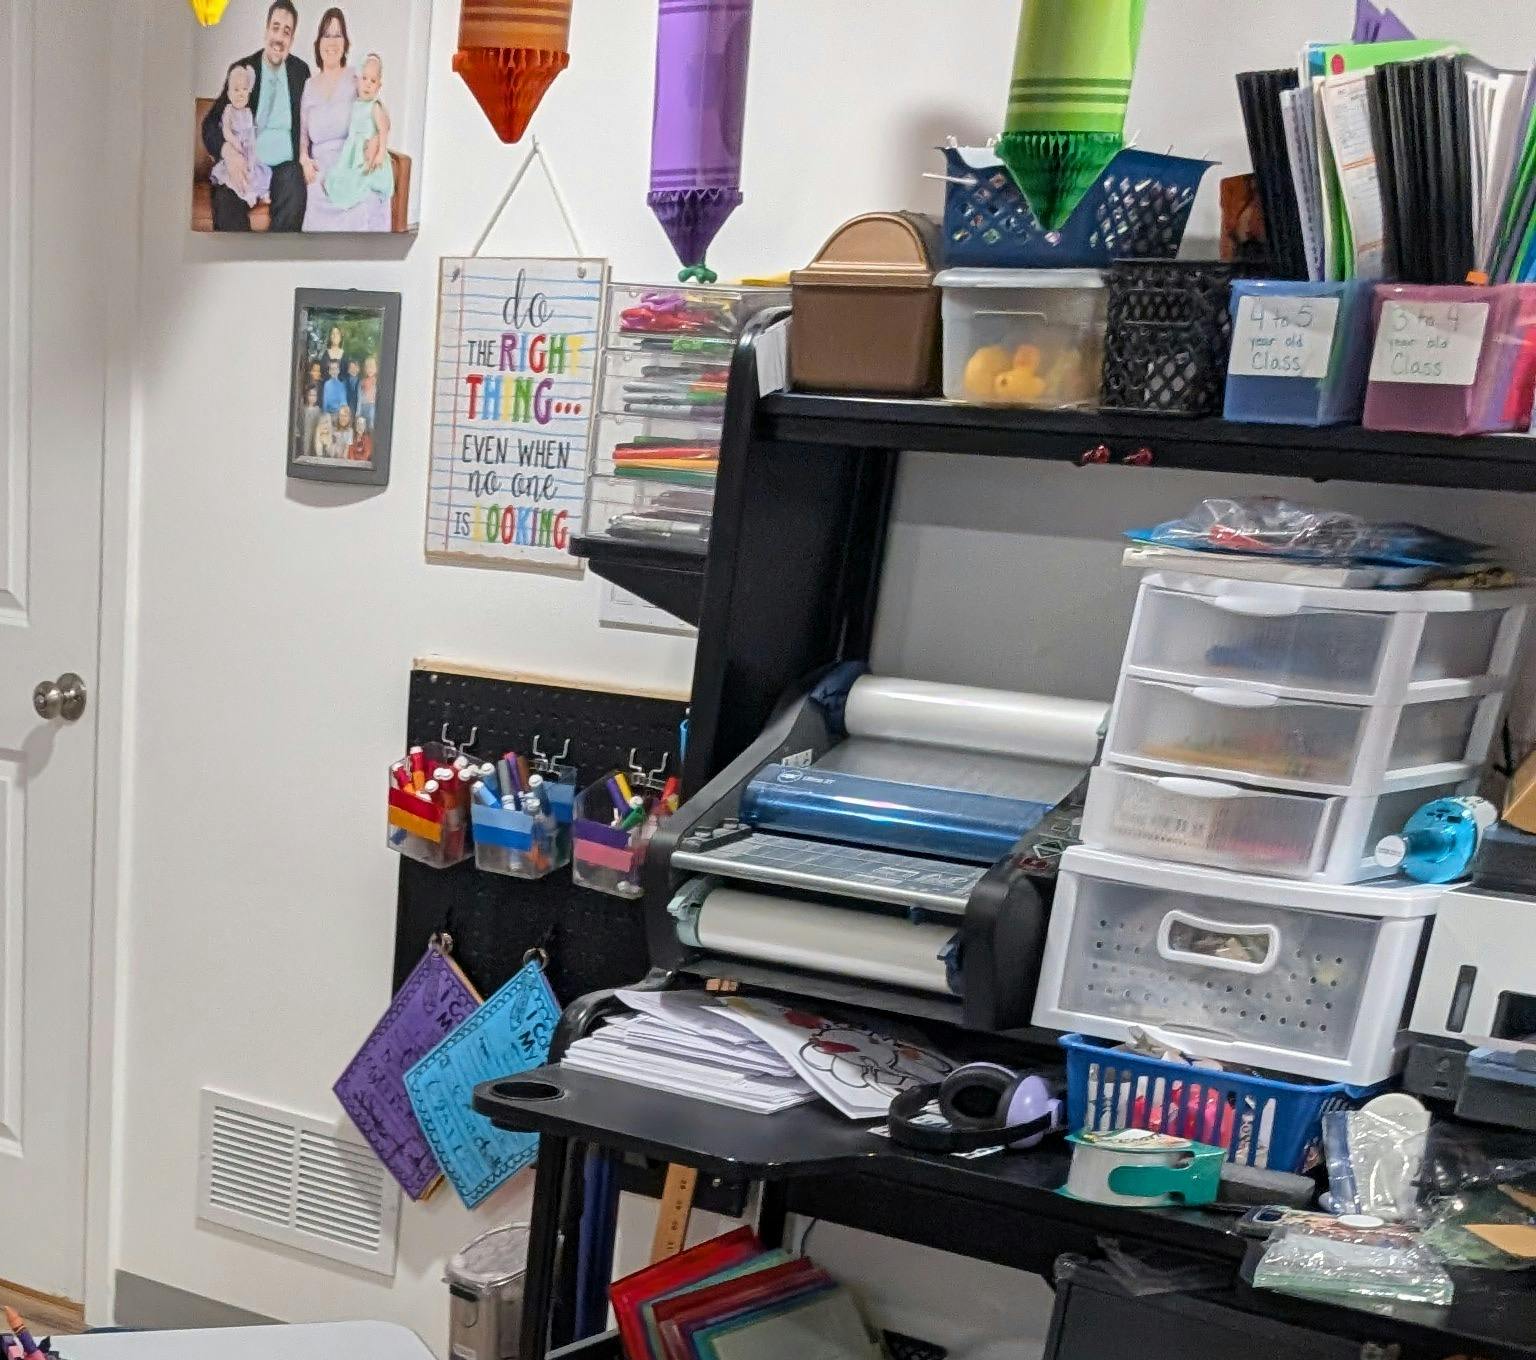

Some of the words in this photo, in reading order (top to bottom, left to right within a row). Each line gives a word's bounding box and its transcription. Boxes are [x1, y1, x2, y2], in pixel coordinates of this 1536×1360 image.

[503, 268, 554, 329] do
[1250, 302, 1264, 331] 4
[1273, 308, 1290, 329] to
[1297, 304, 1313, 328] 5
[1391, 307, 1410, 332] 3
[1447, 304, 1462, 332] 4
[467, 340, 496, 367] THE
[499, 332, 584, 375] RIGHT
[1249, 335, 1275, 351] year
[1285, 335, 1304, 348] old
[1251, 350, 1302, 373] Class
[1391, 352, 1442, 377] Class
[466, 374, 582, 425] THING...
[461, 434, 509, 465] EVEN
[517, 438, 570, 469] WHEN
[468, 470, 502, 498] no
[511, 472, 560, 502] one
[454, 511, 470, 536] IS
[472, 504, 568, 550] LOOKING
